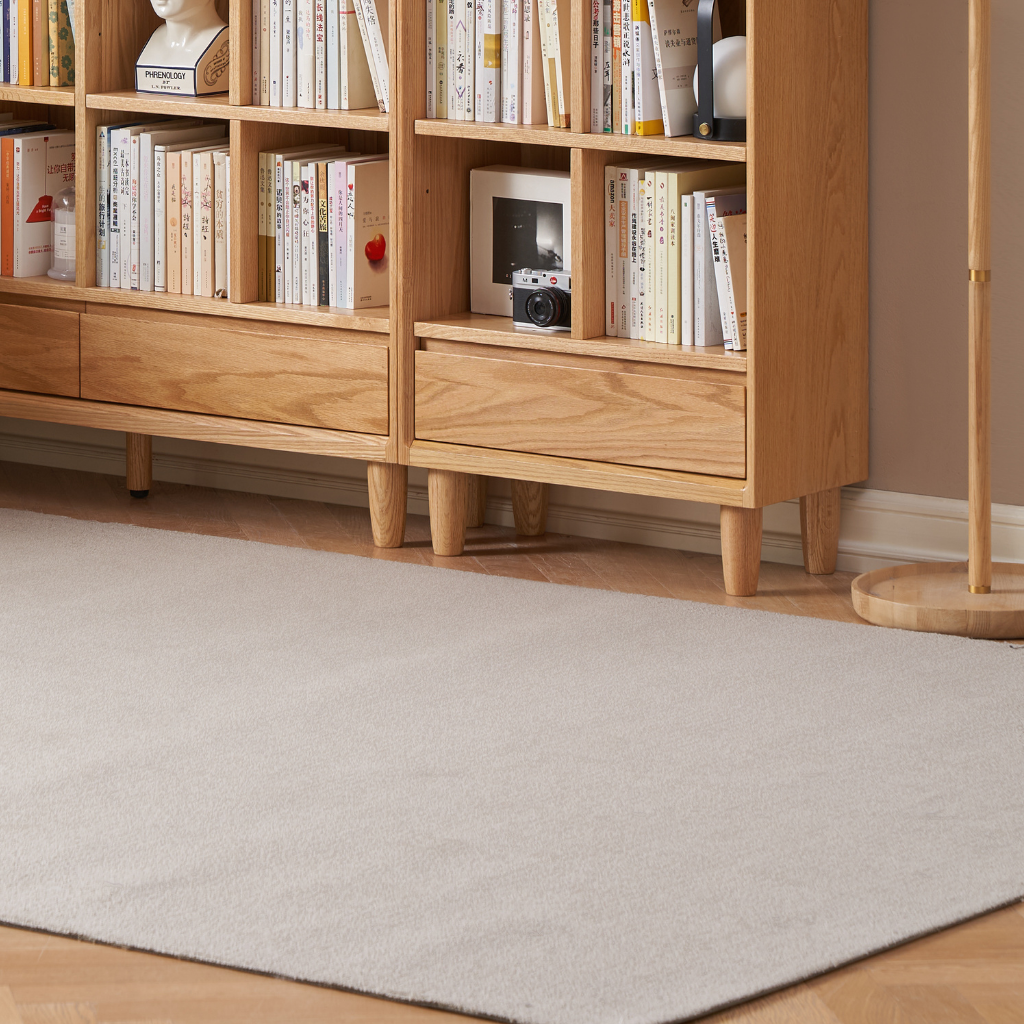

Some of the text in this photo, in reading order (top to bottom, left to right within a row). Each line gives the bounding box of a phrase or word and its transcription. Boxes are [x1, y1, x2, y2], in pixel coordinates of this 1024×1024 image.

[145, 70, 186, 80] PHRENOLOGY
[46, 163, 76, 174] 让你自带
[215, 189, 225, 240] 贫穷的本质
[318, 199, 328, 232] 文化苦旅
